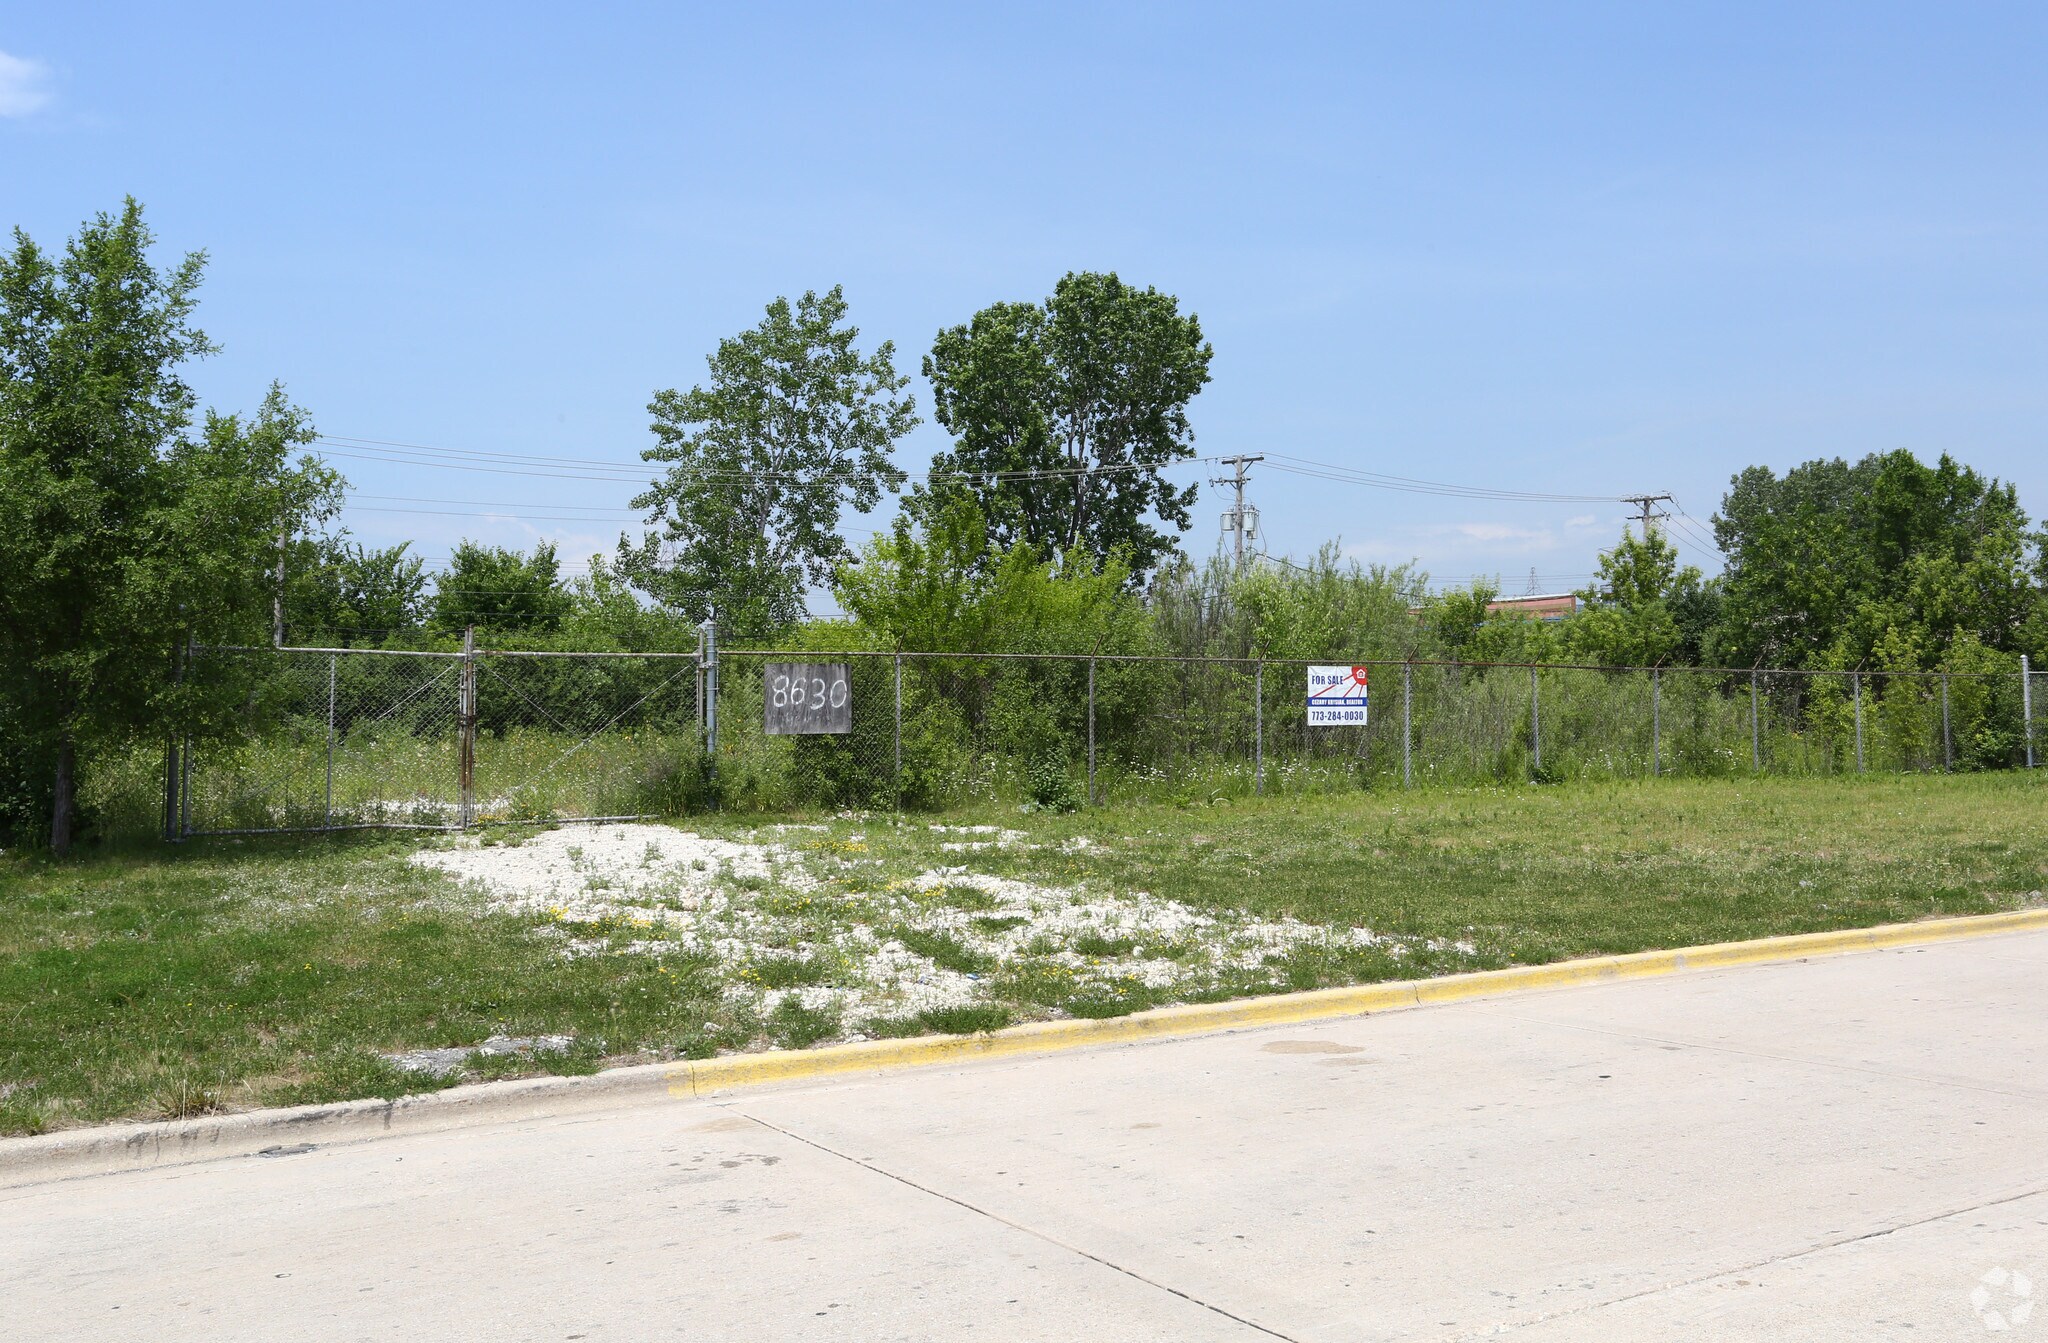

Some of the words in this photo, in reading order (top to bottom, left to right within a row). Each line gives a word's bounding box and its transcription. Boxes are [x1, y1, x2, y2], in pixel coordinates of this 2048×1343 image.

[1312, 676, 1325, 685] FOR
[1328, 675, 1343, 684] SALE
[772, 675, 847, 710] 8630
[1312, 711, 1363, 720] 773-284-0030
